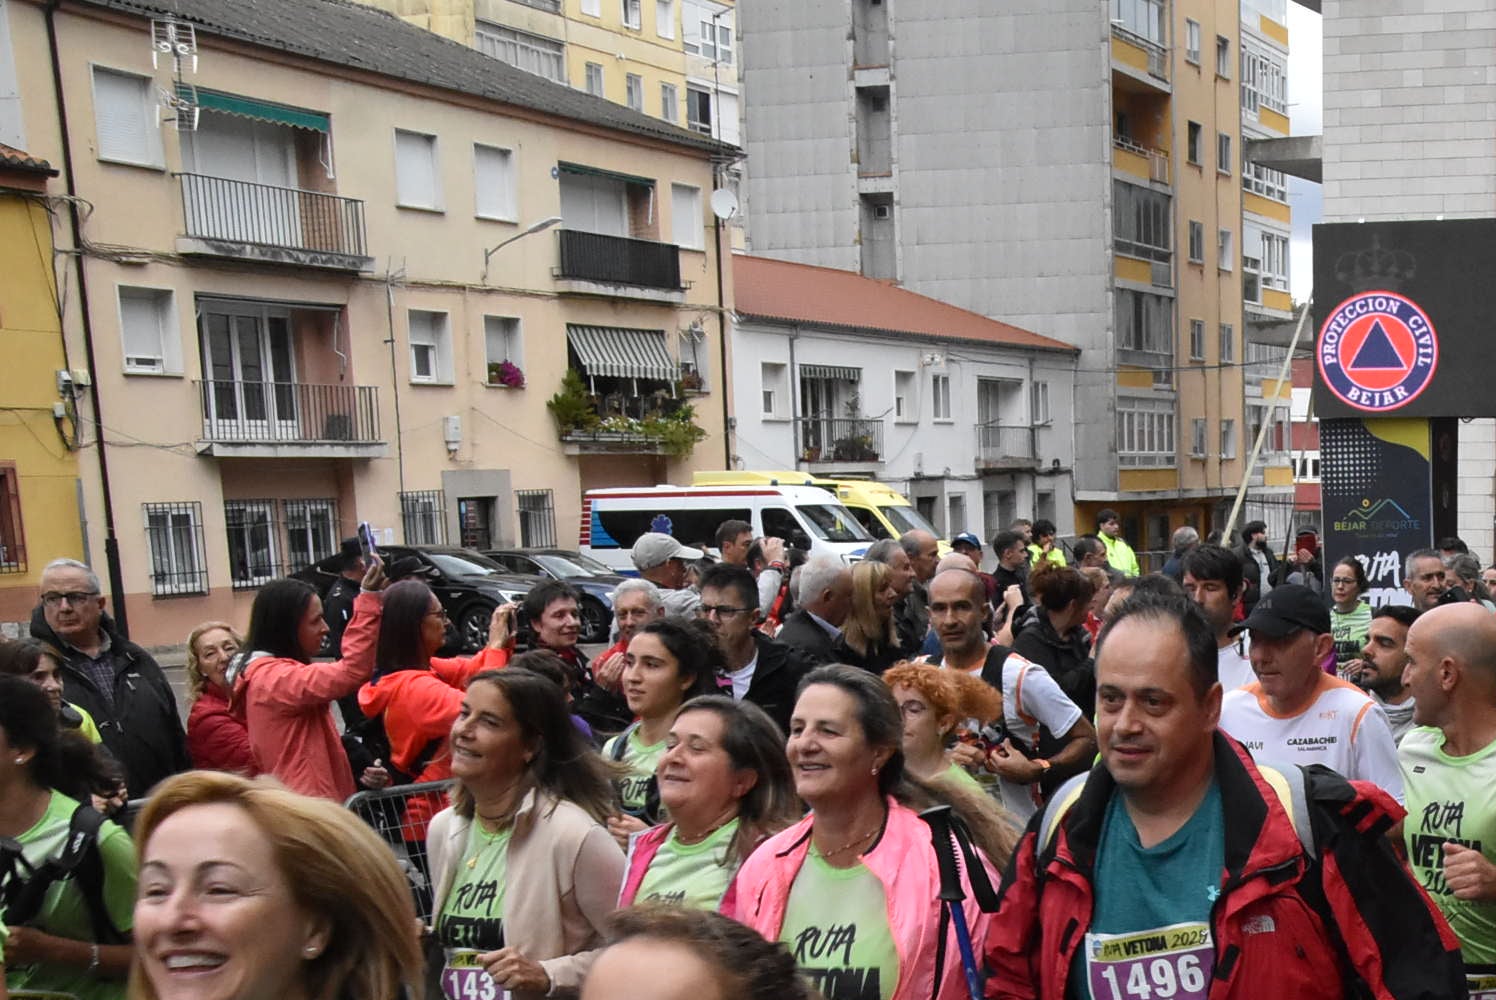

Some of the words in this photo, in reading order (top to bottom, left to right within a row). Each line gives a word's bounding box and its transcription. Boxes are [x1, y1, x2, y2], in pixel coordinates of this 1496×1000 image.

[1323, 297, 1401, 366] PROTECCION
[1408, 315, 1433, 367] CIVIL
[1346, 386, 1409, 407] BEJAR
[1420, 800, 1465, 838] RUTA
[452, 880, 498, 916] RUTA
[1423, 869, 1454, 896] 20
[794, 922, 857, 966] RUTA
[1123, 935, 1168, 957] VETONA
[1171, 929, 1209, 949] 2025
